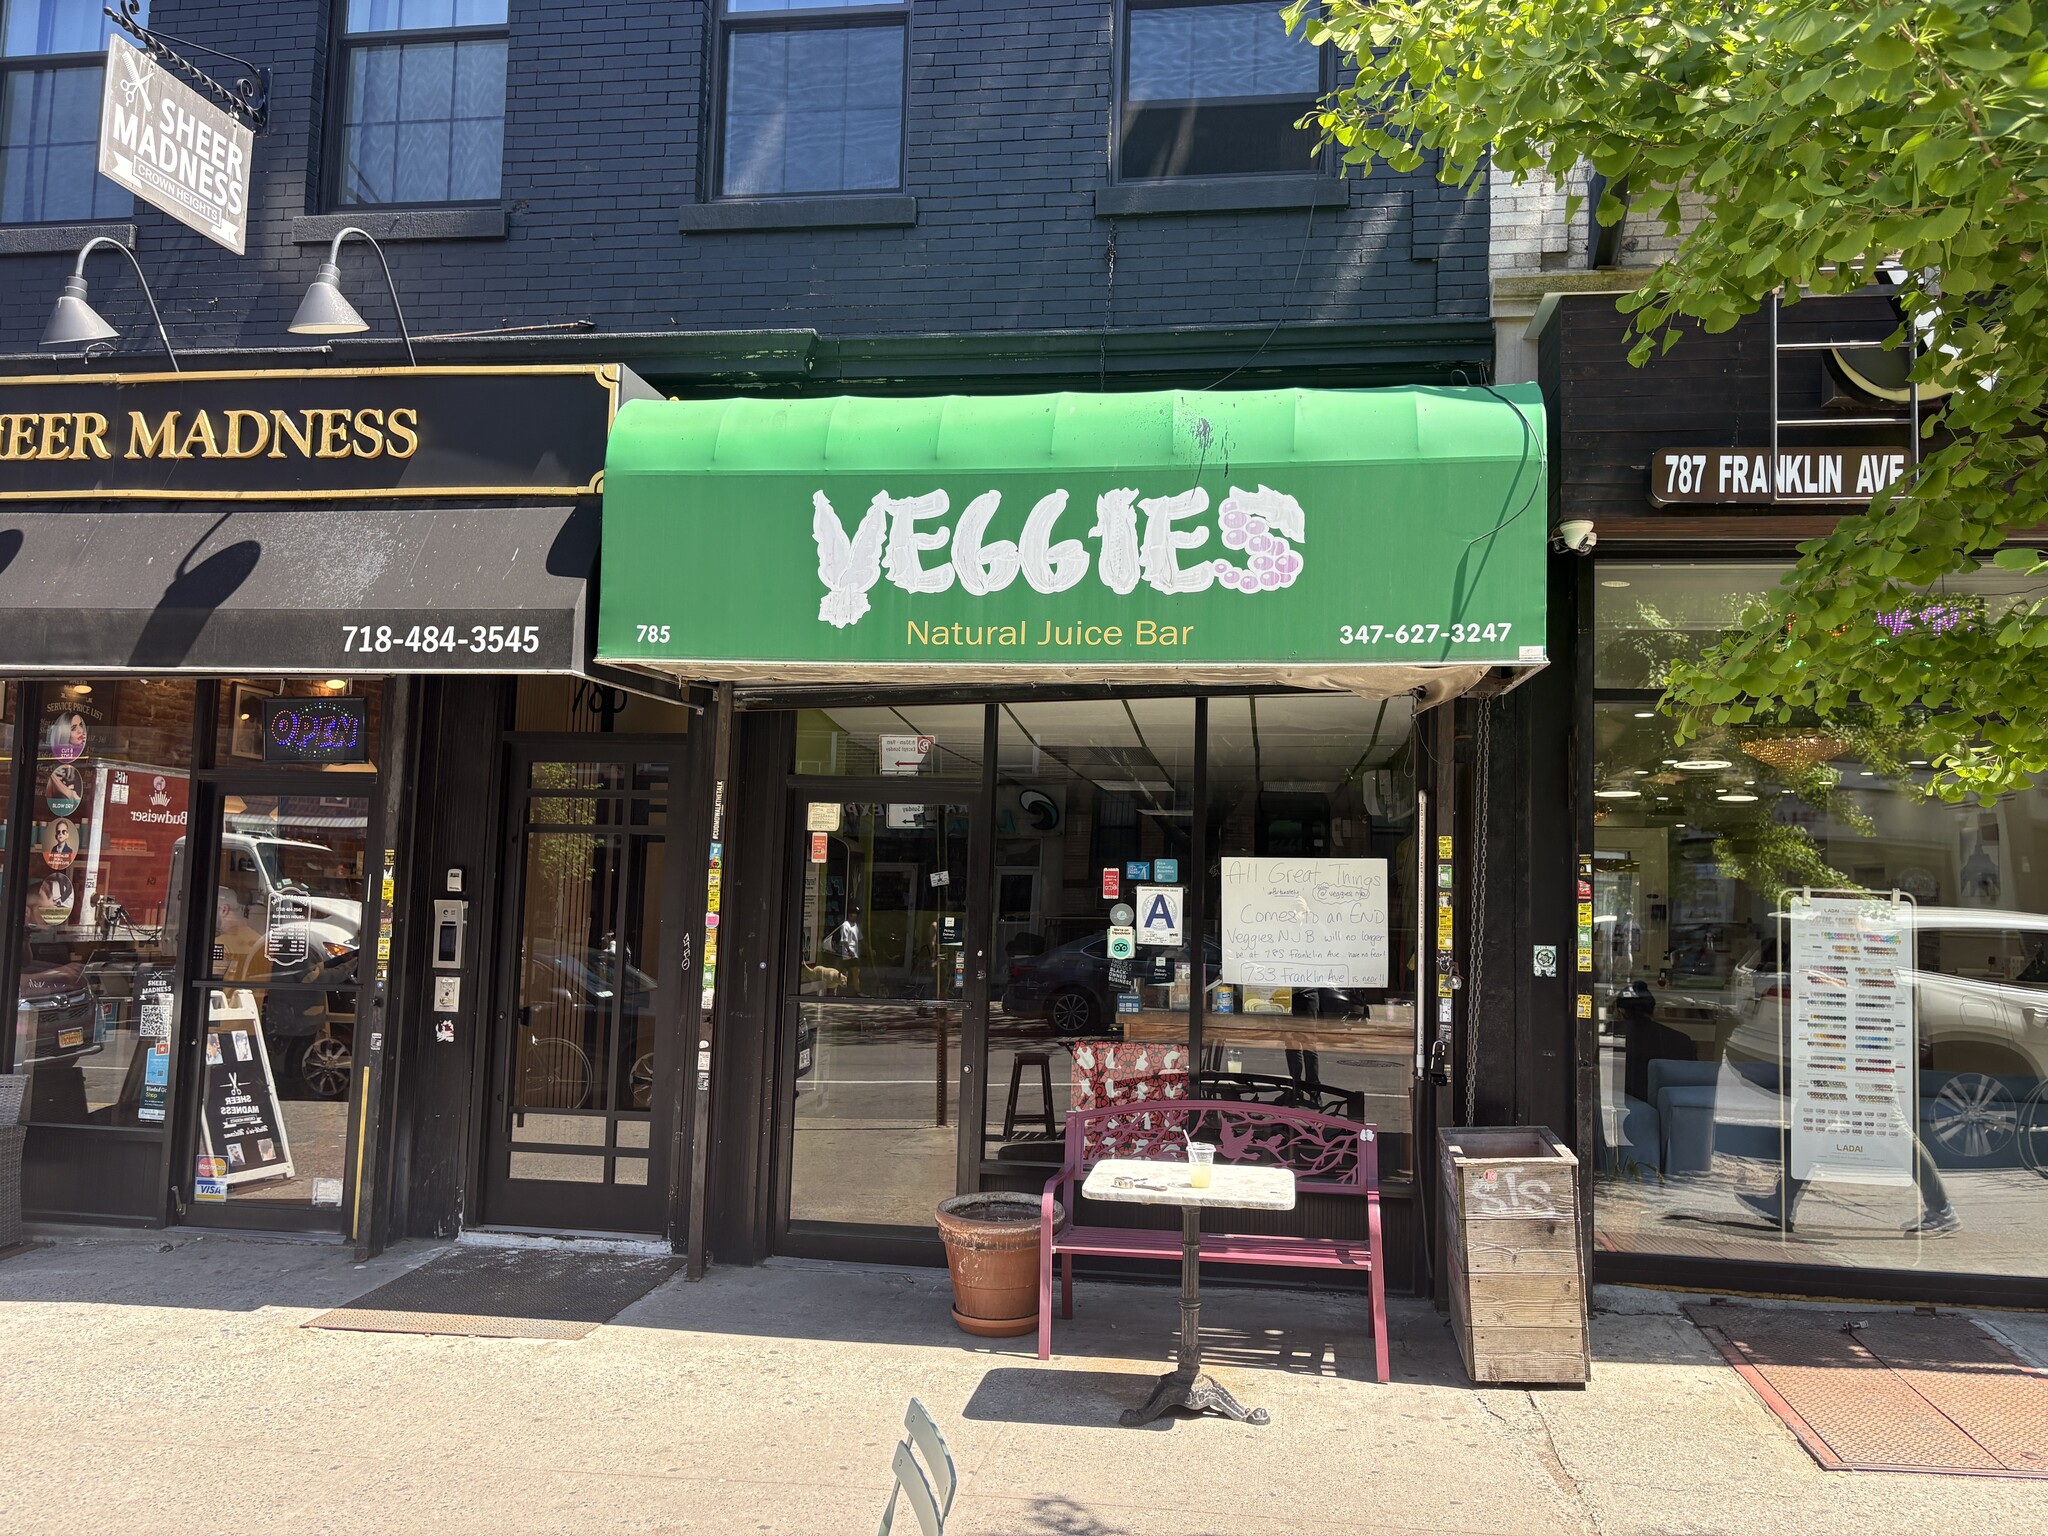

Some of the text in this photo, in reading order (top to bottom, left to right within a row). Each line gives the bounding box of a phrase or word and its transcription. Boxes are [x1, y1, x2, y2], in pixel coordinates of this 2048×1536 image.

[159, 97, 243, 183] SHEER
[113, 103, 243, 216] MADNESS
[138, 165, 219, 221] CROWN HEIGHTS
[0, 408, 420, 461] EER MADNESS
[1665, 454, 1707, 494] 787
[1718, 454, 1842, 494] FRANKLIN
[812, 482, 1306, 629] VEGGIES
[342, 625, 540, 653] 718-484-3545
[636, 624, 671, 643] 785
[906, 619, 1194, 646] Natural Juice Bar
[1339, 622, 1513, 645] 347-627-3247
[47, 702, 104, 721] SERVICE PRICE LIST
[271, 709, 359, 748] OPEN
[1225, 861, 1382, 892] All Great Things
[1144, 894, 1175, 929] A
[1240, 903, 1298, 924] Comes
[1326, 911, 1343, 924] an
[1349, 902, 1385, 924] END
[1226, 928, 1274, 950] Veggies
[1324, 930, 1341, 942] will
[1345, 934, 1357, 943] no
[1248, 950, 1260, 959] at
[1264, 949, 1284, 959] 785
[1289, 949, 1323, 960] Franklin
[1326, 950, 1340, 959] Ave
[1108, 971, 1127, 979] OWNED
[1108, 976, 1132, 986] BUSINESS
[1244, 966, 1276, 982] 733
[1280, 967, 1324, 983] Franklin
[1324, 969, 1345, 983] Ave
[1351, 974, 1359, 983] is
[141, 986, 172, 995] MADNESS
[1836, 1144, 1863, 1153] LADAI
[200, 1185, 221, 1194] VISA
